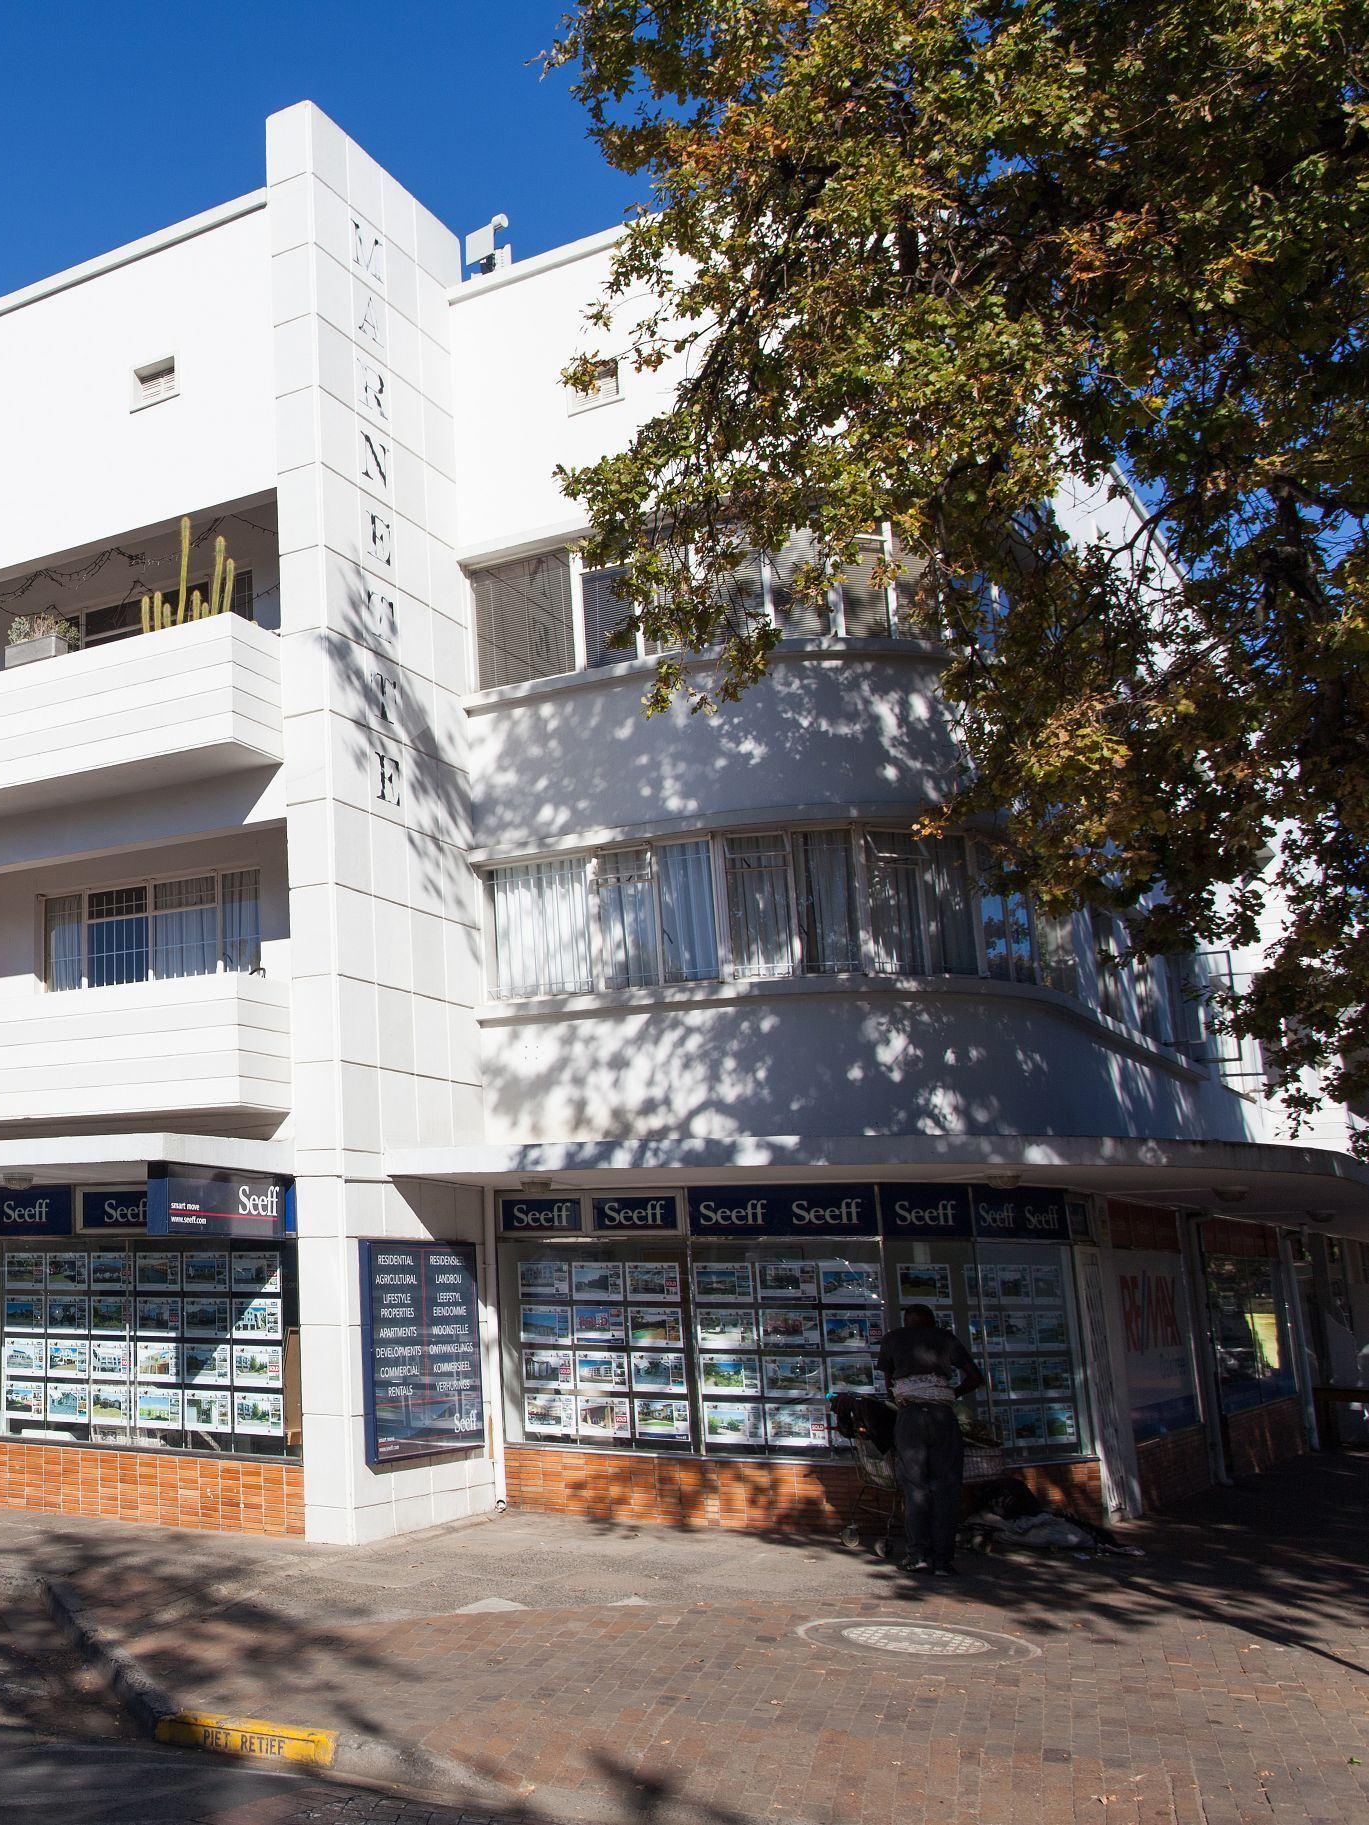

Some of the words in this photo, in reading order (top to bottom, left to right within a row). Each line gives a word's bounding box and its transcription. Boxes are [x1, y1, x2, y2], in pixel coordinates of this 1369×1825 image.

[170, 1202, 186, 1210] smart
[186, 1203, 200, 1211] move
[238, 1185, 279, 1217] Seeff
[3, 1199, 50, 1223] Seeff
[104, 1198, 148, 1222] Seef
[513, 1203, 571, 1227] Seeff
[604, 1201, 665, 1226] Seeff
[699, 1200, 767, 1225] Seeff
[792, 1199, 862, 1225] Seeff
[894, 1200, 957, 1226] Seeff
[978, 1202, 1017, 1228] Seeff
[1024, 1205, 1059, 1229] Seeff
[170, 1216, 207, 1225] www.seeff.com
[377, 1254, 414, 1266] RESIDENTIAL
[375, 1274, 418, 1285] AGRICULTURAL
[435, 1273, 462, 1284] LANDBOU
[383, 1293, 411, 1304] LIFESTYLE
[437, 1292, 462, 1303] LEEFSTYL
[380, 1308, 415, 1319] PROPERTIES
[433, 1306, 467, 1317] EIENDOMME
[379, 1326, 417, 1338] APARTMENTS
[432, 1324, 469, 1335] WOONSTELLE
[375, 1345, 422, 1359] DEVELOPMENTS
[429, 1342, 473, 1355] ONTWIKKELINGS
[380, 1365, 420, 1378] COMMERCIAL
[433, 1361, 471, 1374] KOMMERSIEEL
[388, 1385, 413, 1397] RENTALS
[436, 1379, 470, 1392] VERHURINGS
[454, 1410, 477, 1433] Seeff
[203, 1729, 231, 1749] PIET
[240, 1735, 286, 1756] RETIEF
